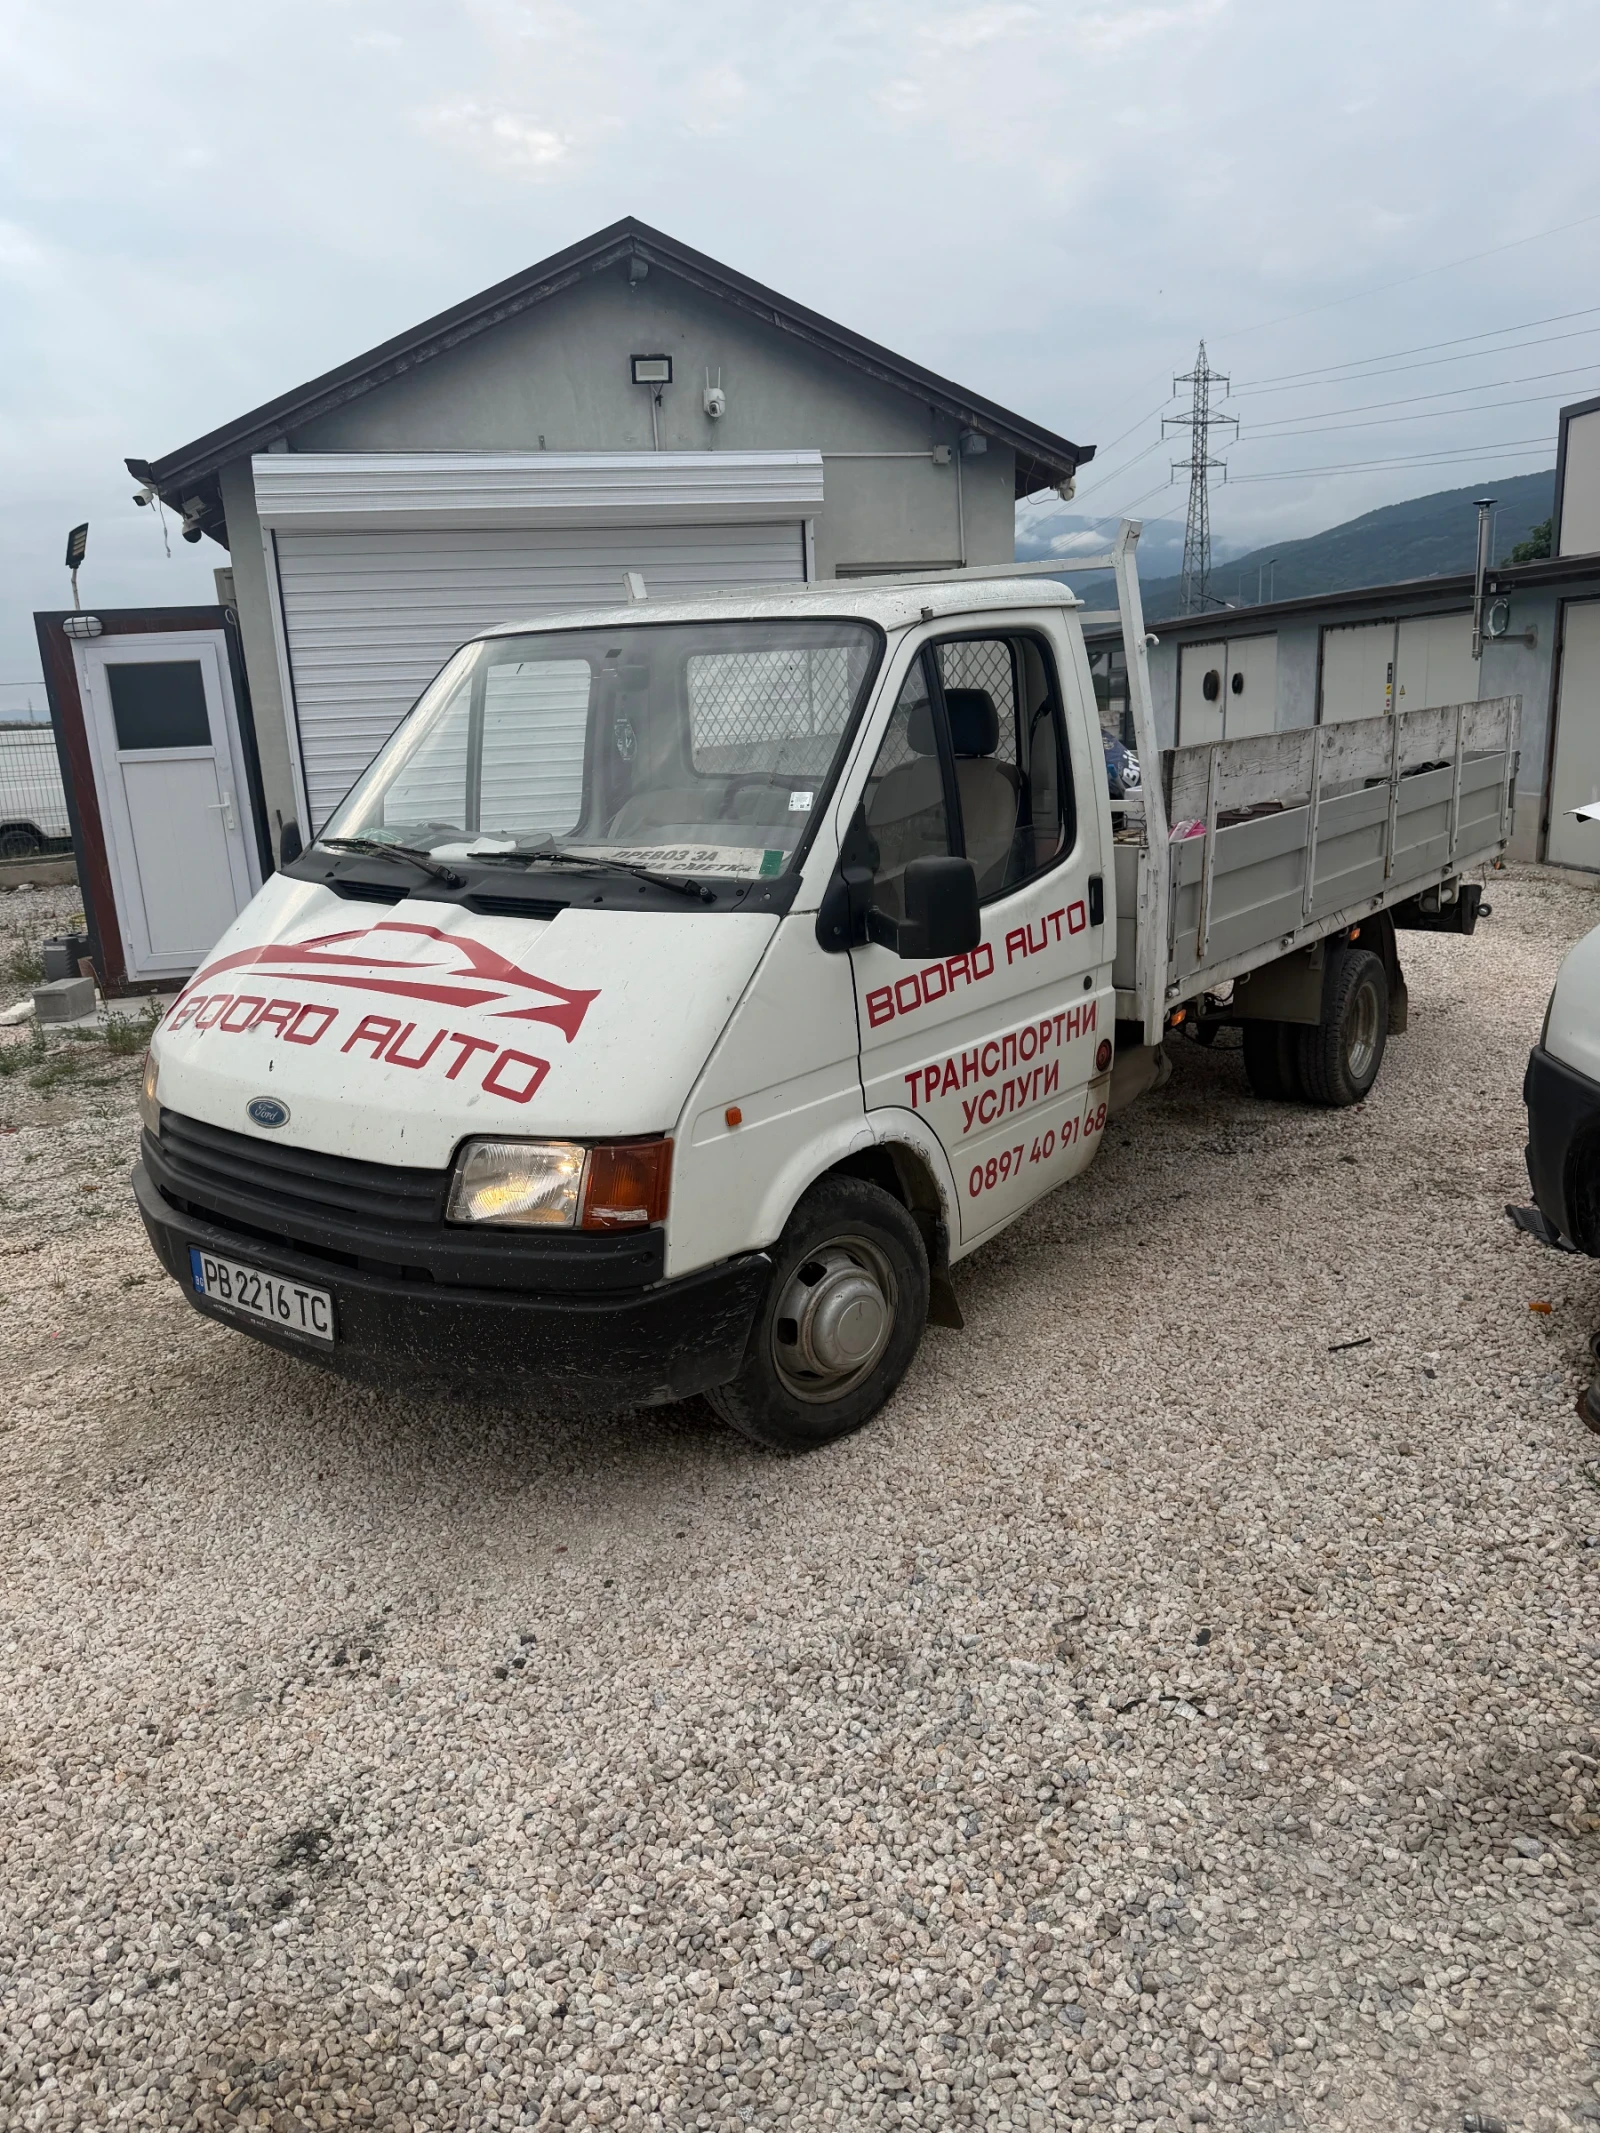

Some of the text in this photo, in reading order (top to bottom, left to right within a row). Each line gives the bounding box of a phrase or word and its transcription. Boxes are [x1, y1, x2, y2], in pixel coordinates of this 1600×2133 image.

[612, 850, 718, 862] ПРЕВОЗ ЗА
[866, 900, 1086, 1029] BODRO AUTO
[167, 994, 551, 1104] BODRO AUTO
[904, 1000, 1097, 1109] ТРАНСПОРТНИ
[961, 1059, 1059, 1134] УСЛУГИ
[969, 1102, 1107, 1198] 0897 40 91 68
